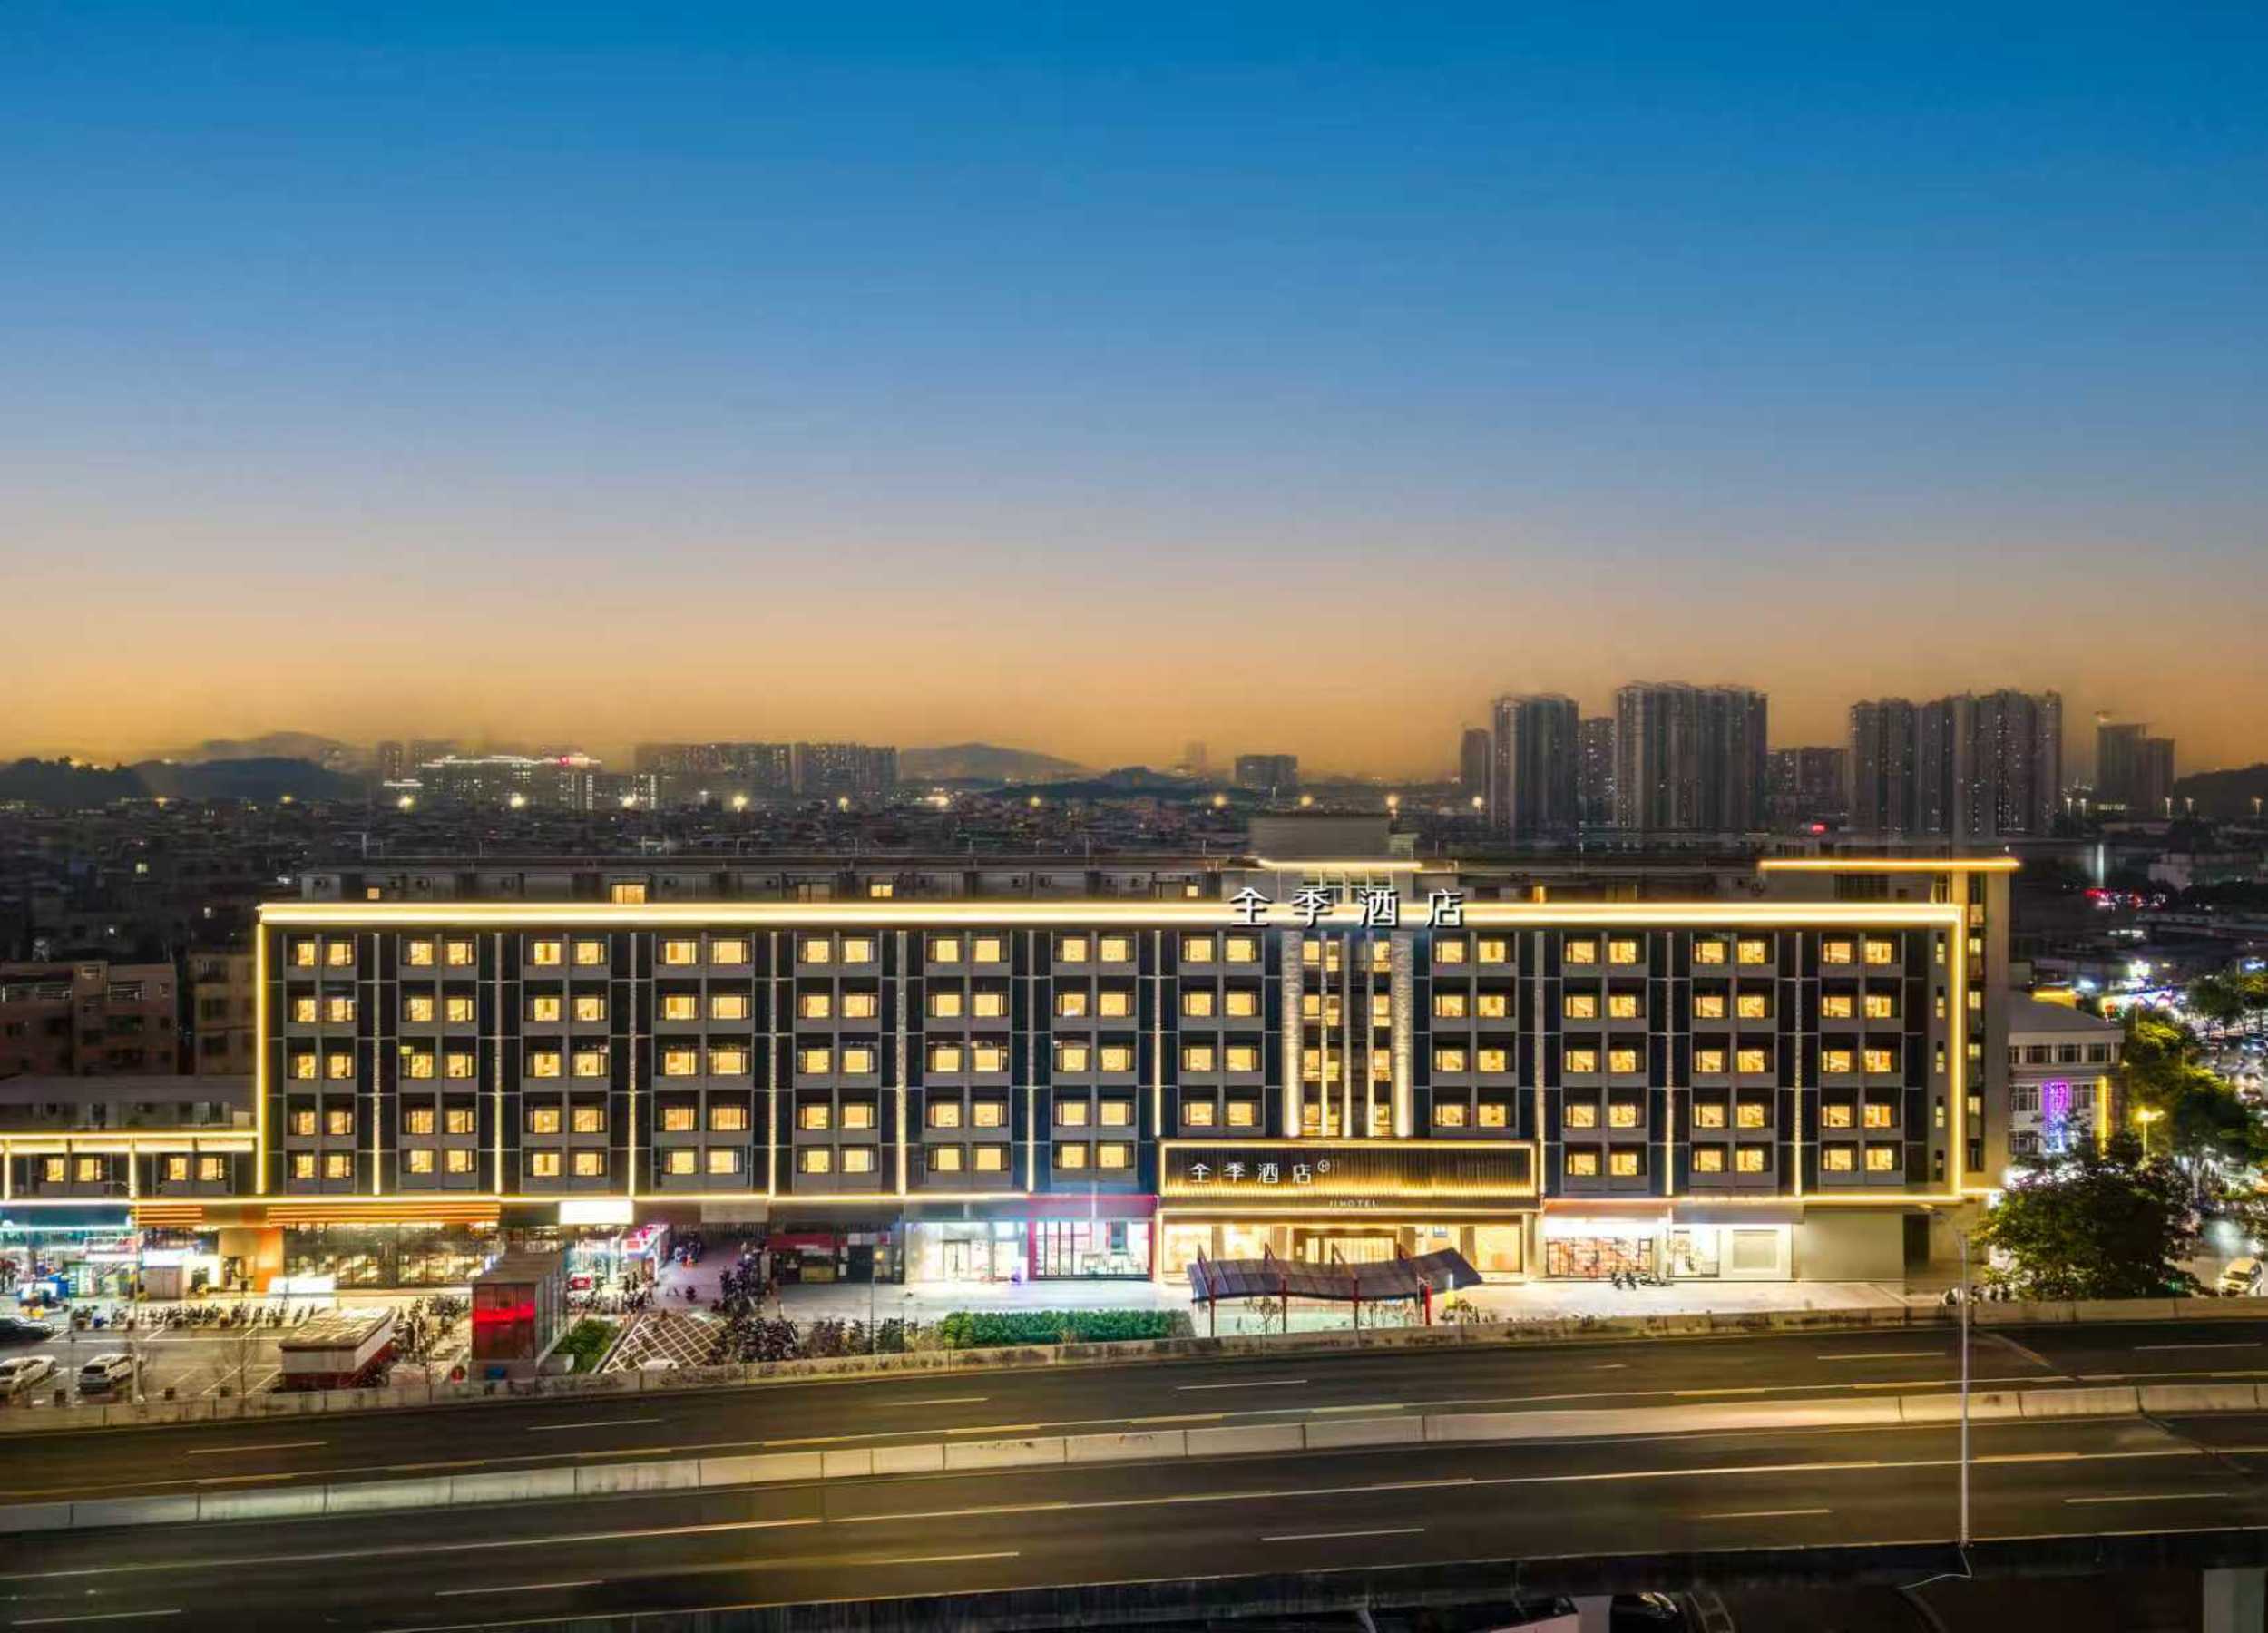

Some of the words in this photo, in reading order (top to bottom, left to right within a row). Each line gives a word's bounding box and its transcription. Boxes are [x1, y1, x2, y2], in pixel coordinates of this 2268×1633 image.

[1230, 886, 1465, 928] 全季酒店
[1189, 1161, 1312, 1184] 全季酒店
